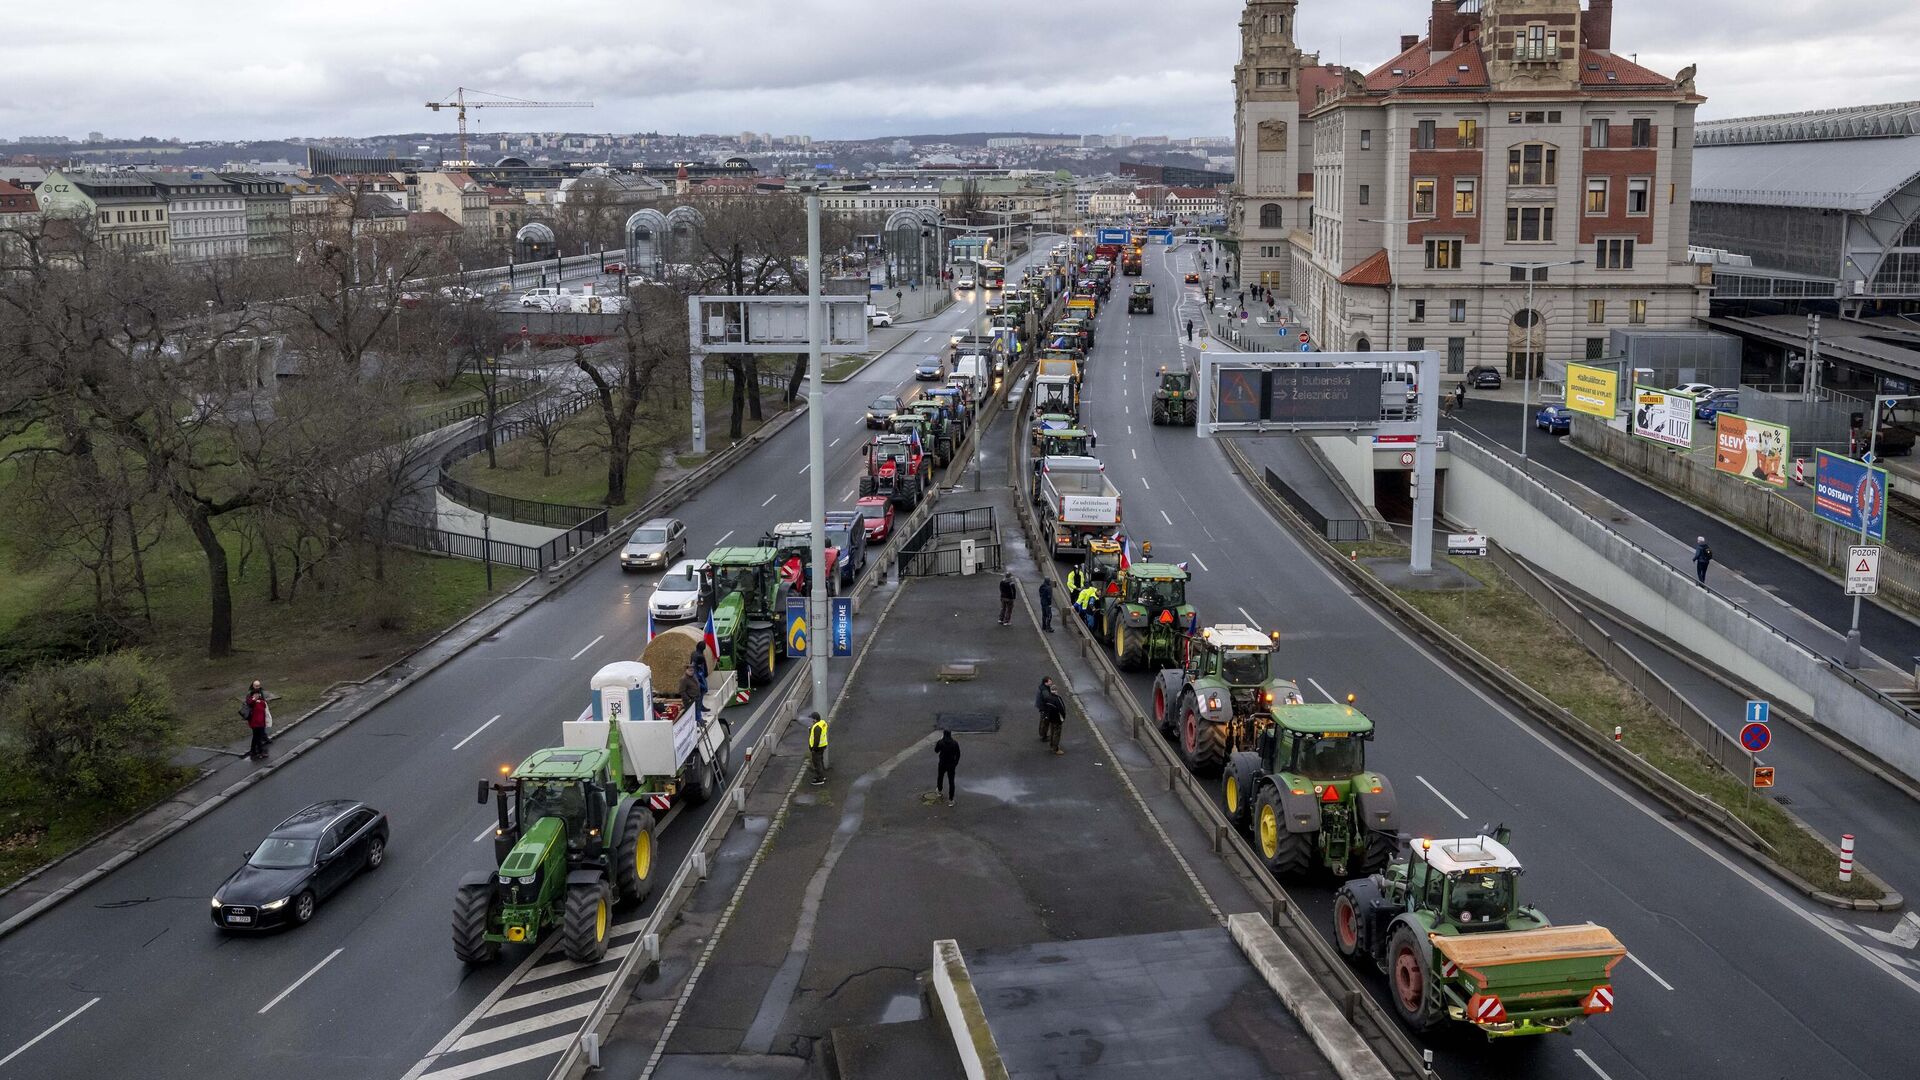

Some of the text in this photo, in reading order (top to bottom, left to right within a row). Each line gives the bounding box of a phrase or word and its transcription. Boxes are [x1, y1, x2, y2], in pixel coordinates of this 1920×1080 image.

[54, 184, 70, 193] CZ
[1273, 375, 1351, 386] ulice Bubenská
[1292, 388, 1349, 400] Železničářů
[1670, 397, 1691, 411] MUZEUM
[1669, 419, 1690, 439] ILUZÍ
[1719, 434, 1743, 449] SLEVY
[1818, 483, 1854, 504] DO OSTRAVY
[1851, 549, 1877, 557] POZOR
[838, 605, 847, 650] ZAHŘEJEME
